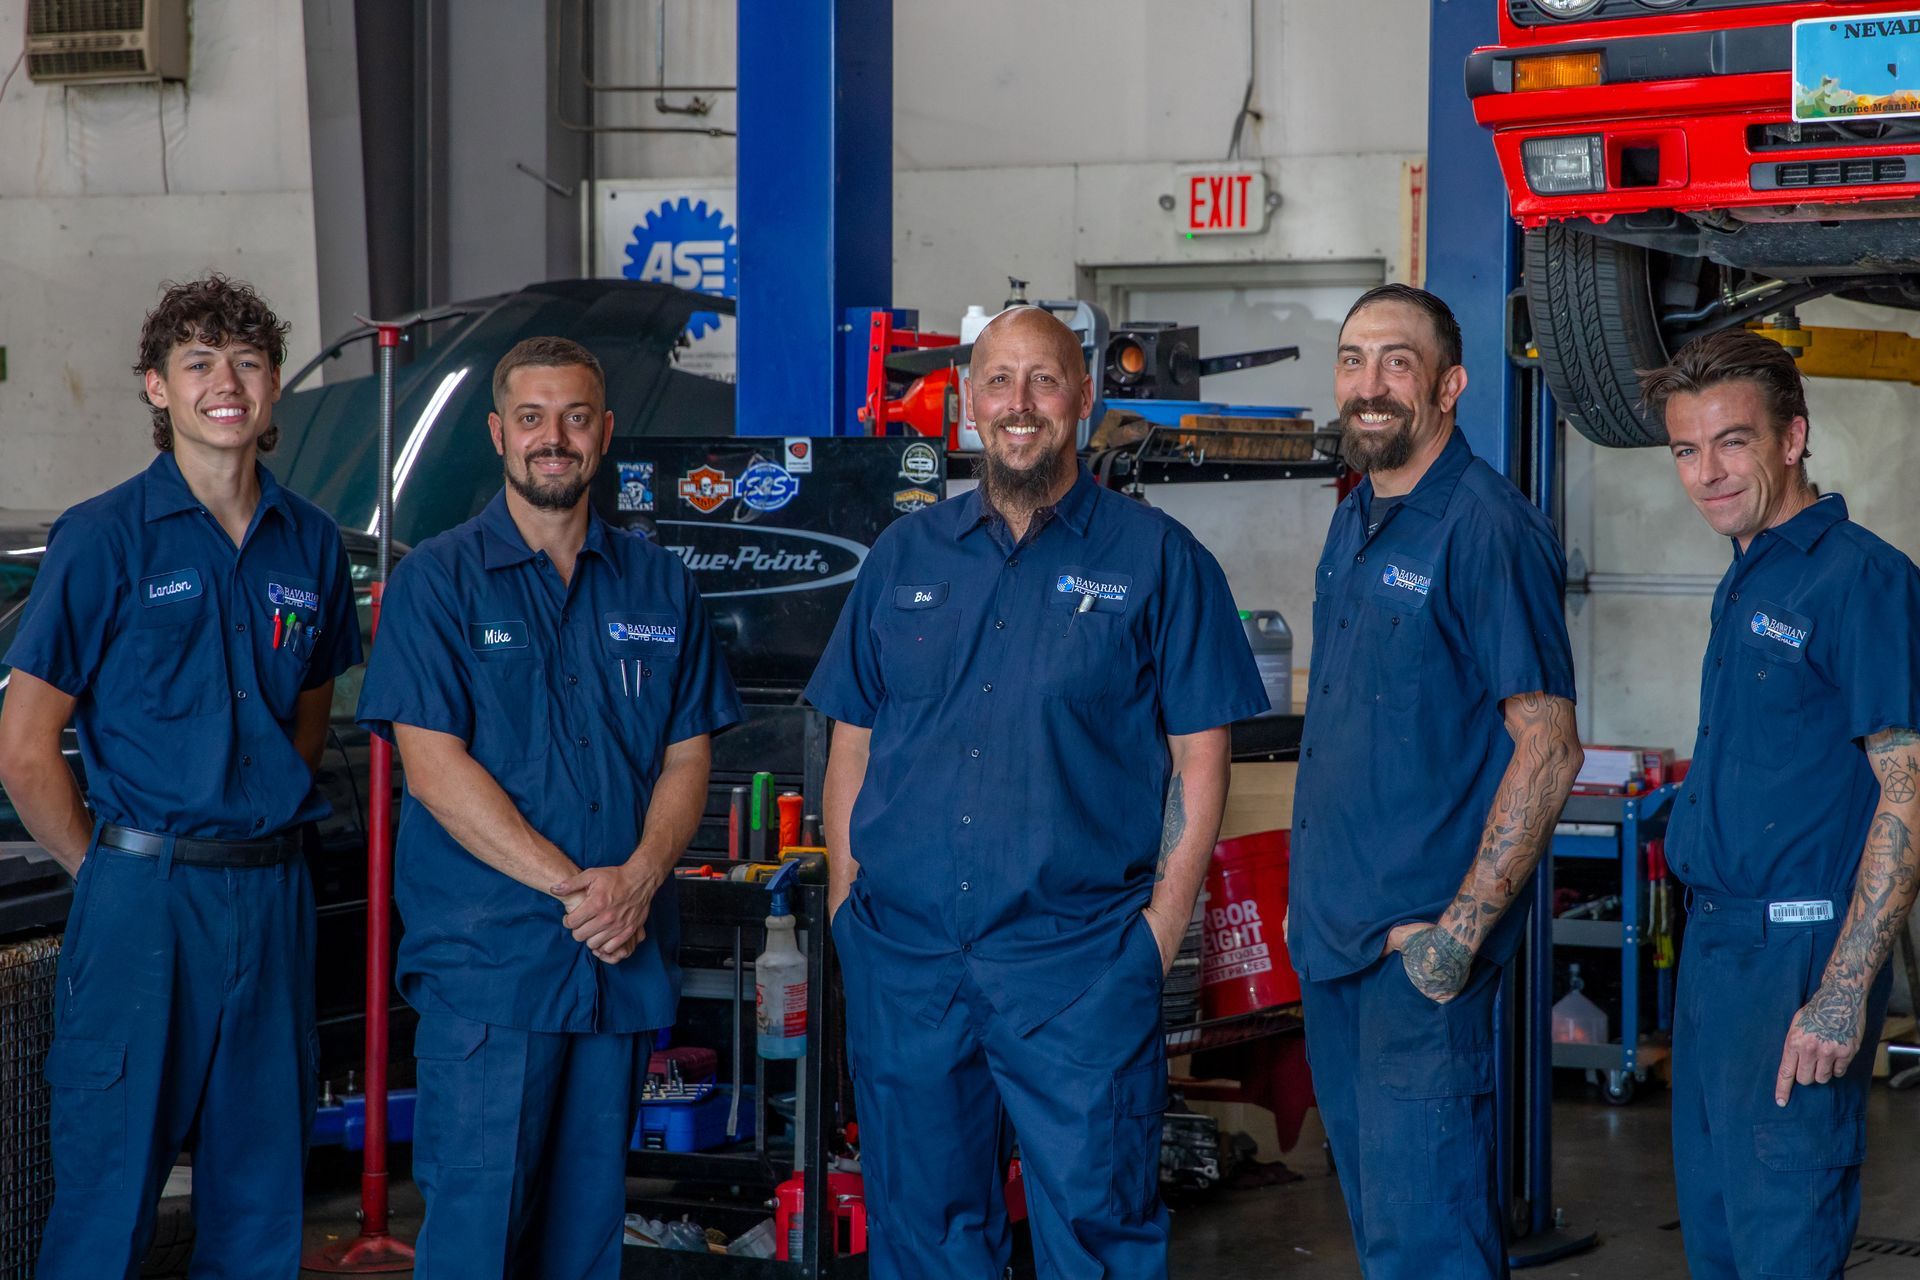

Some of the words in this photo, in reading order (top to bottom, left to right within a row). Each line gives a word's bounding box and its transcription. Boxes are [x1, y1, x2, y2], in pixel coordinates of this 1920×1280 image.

[1844, 18, 1920, 39] NEVAD
[1839, 105, 1869, 114] Home
[1872, 103, 1907, 112] Means
[1189, 175, 1252, 229] EXIT
[641, 240, 726, 290] ASE
[149, 580, 192, 599] Landon
[1075, 577, 1128, 593] BAVARIAN
[914, 591, 932, 603] Bob
[484, 629, 512, 645] Mike
[627, 623, 676, 635] BAVARIAN
[1204, 899, 1261, 930] RBOR
[1204, 920, 1263, 955] EIGHT
[1229, 946, 1264, 961] TOOLS
